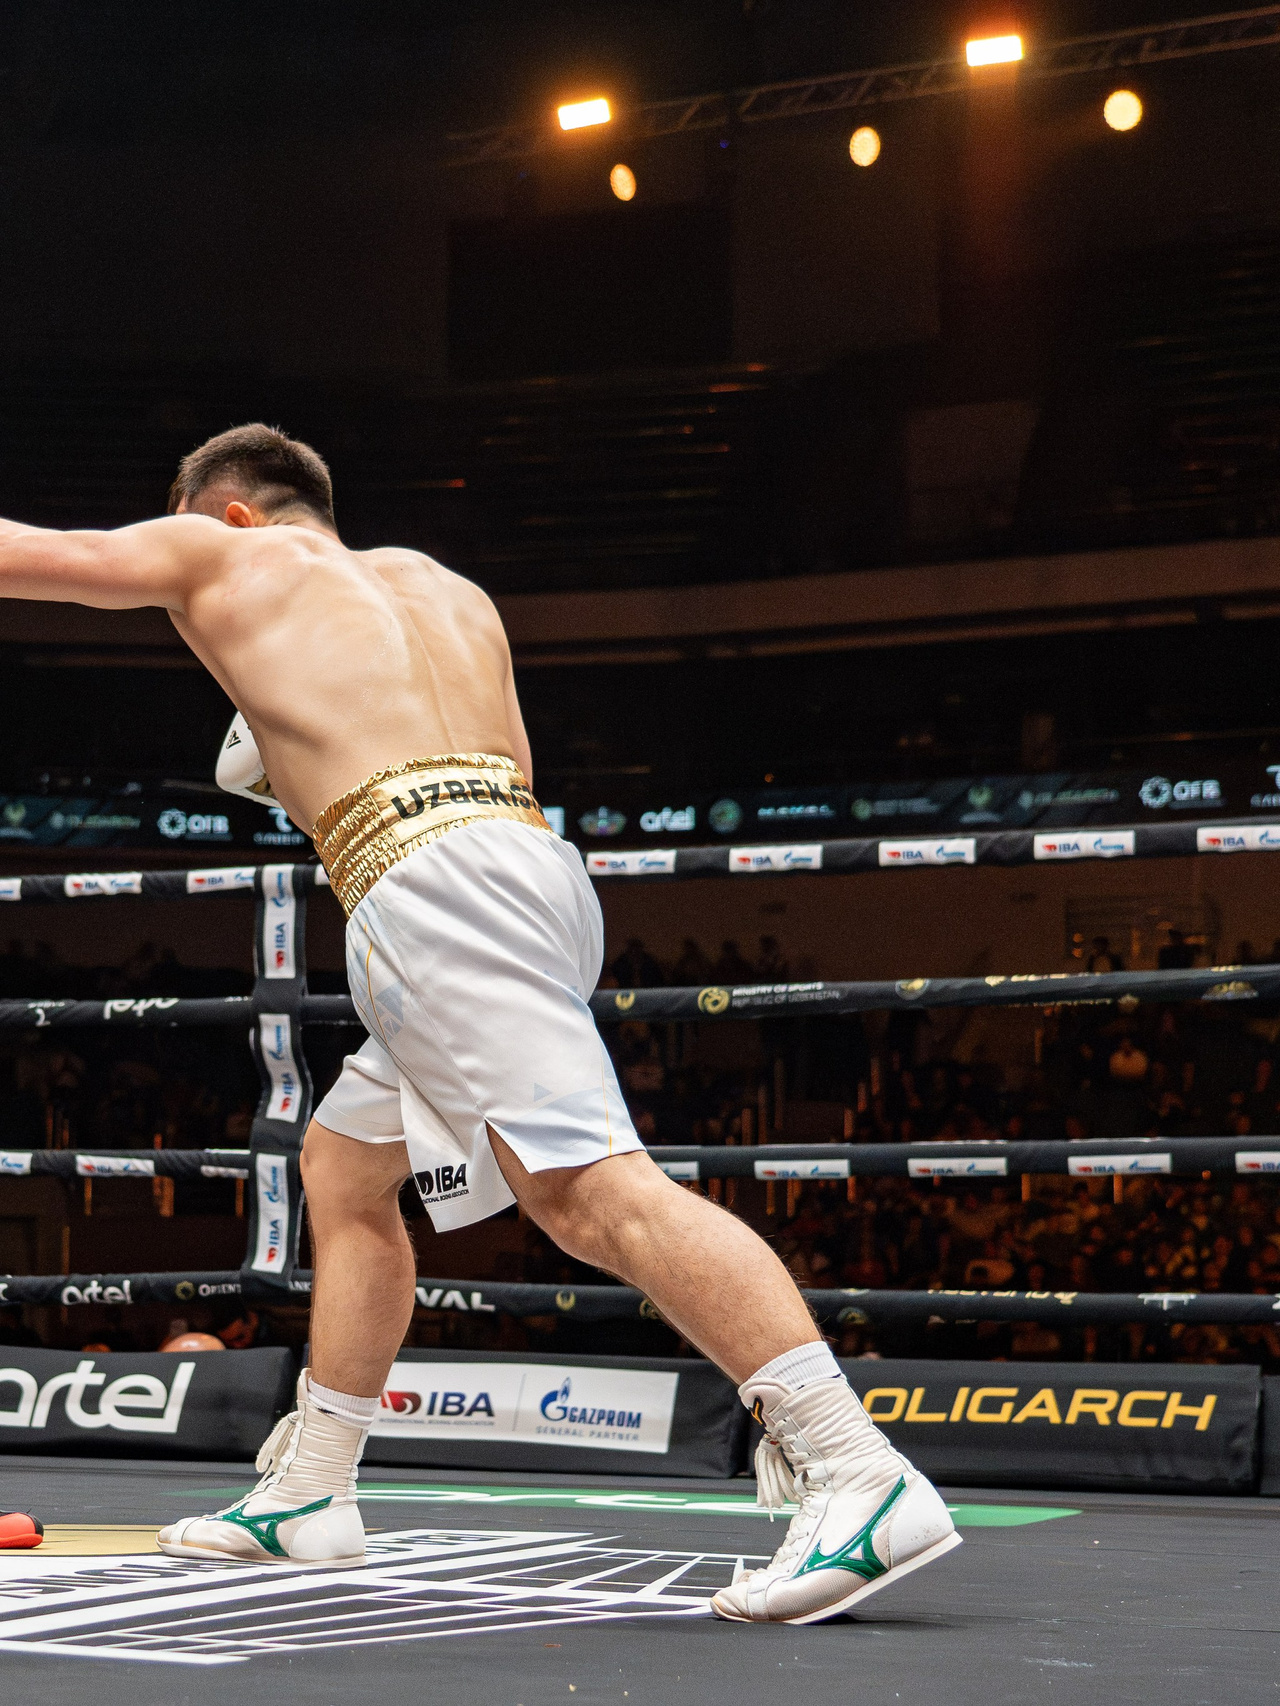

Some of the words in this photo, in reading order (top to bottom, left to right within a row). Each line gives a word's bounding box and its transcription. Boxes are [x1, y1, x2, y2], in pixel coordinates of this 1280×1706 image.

[1057, 842, 1081, 853] IBA
[1222, 837, 1246, 847] IBA
[435, 1163, 468, 1194] IBA
[61, 1279, 133, 1305] artel
[288, 1280, 312, 1292] ANK
[414, 1286, 496, 1312] VAL
[426, 1391, 496, 1418] IBA
[863, 1386, 1218, 1432] OLIGARCH
[568, 1408, 643, 1430] GAZPROM
[535, 1425, 585, 1439] GENERAL
[589, 1430, 640, 1442] PARTNER
